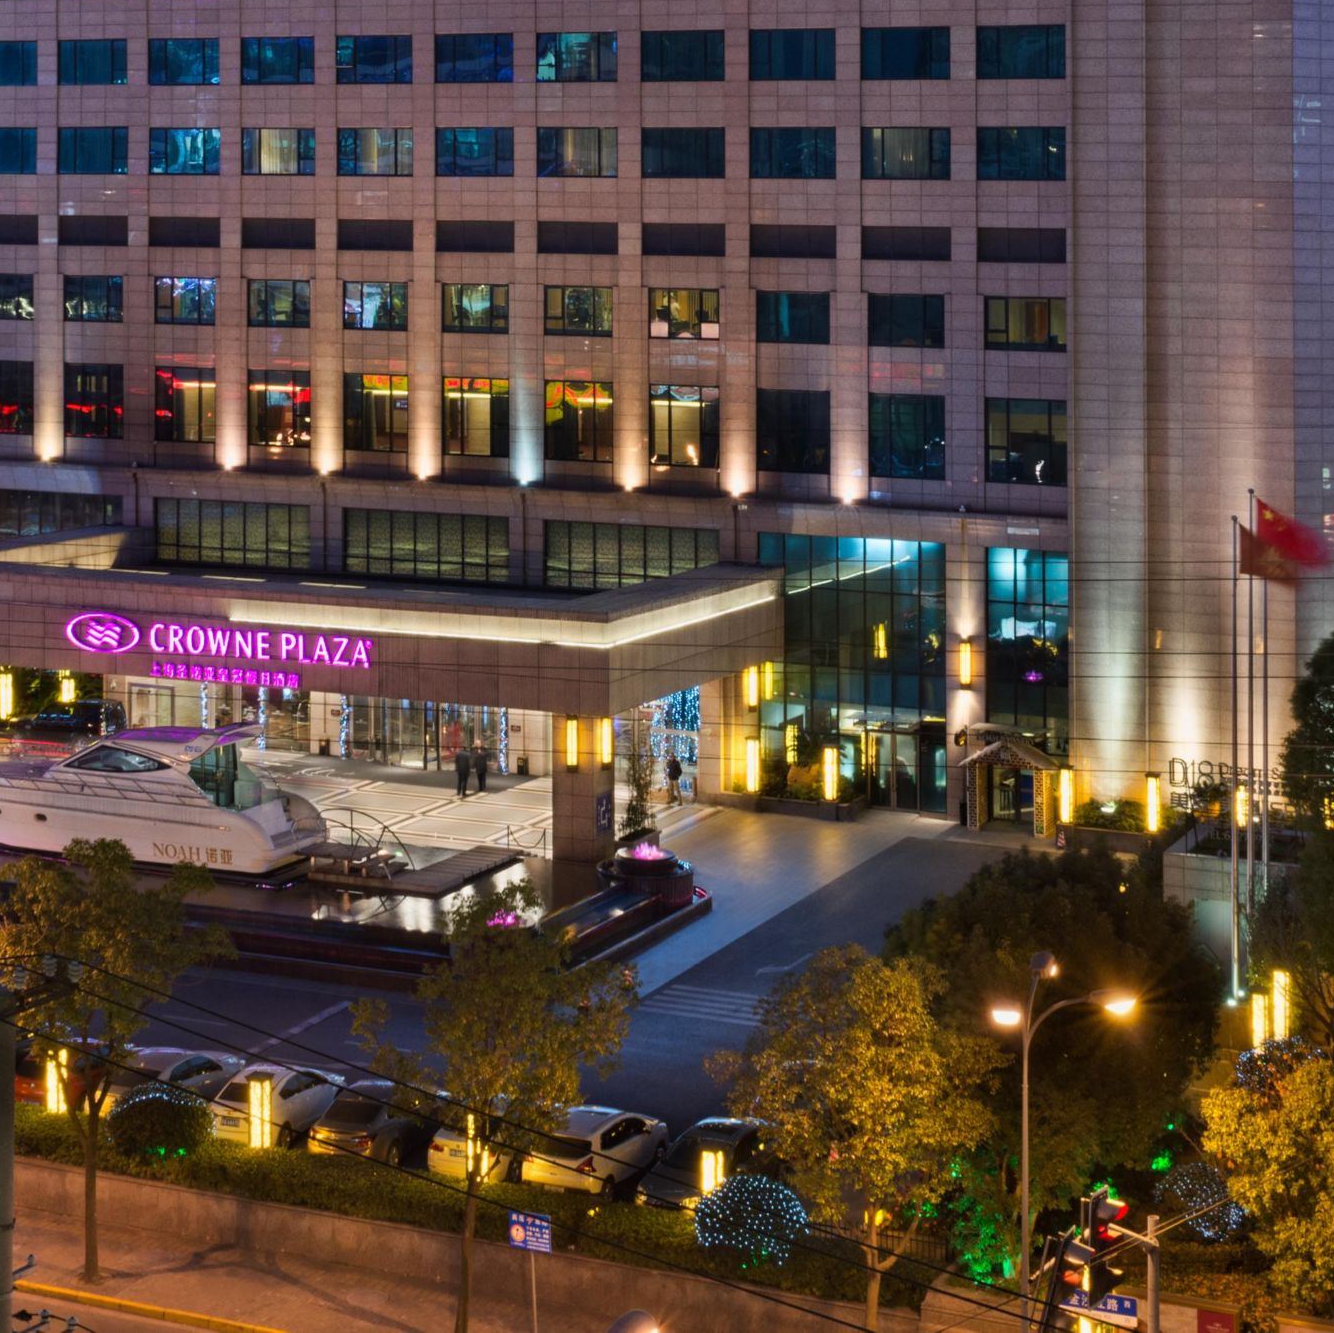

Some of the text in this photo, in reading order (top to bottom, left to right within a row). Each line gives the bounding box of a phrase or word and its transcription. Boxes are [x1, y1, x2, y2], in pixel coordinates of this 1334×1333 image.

[149, 623, 369, 669] CROWNE PLAZA
[152, 841, 233, 865] NOAH 诺亚
